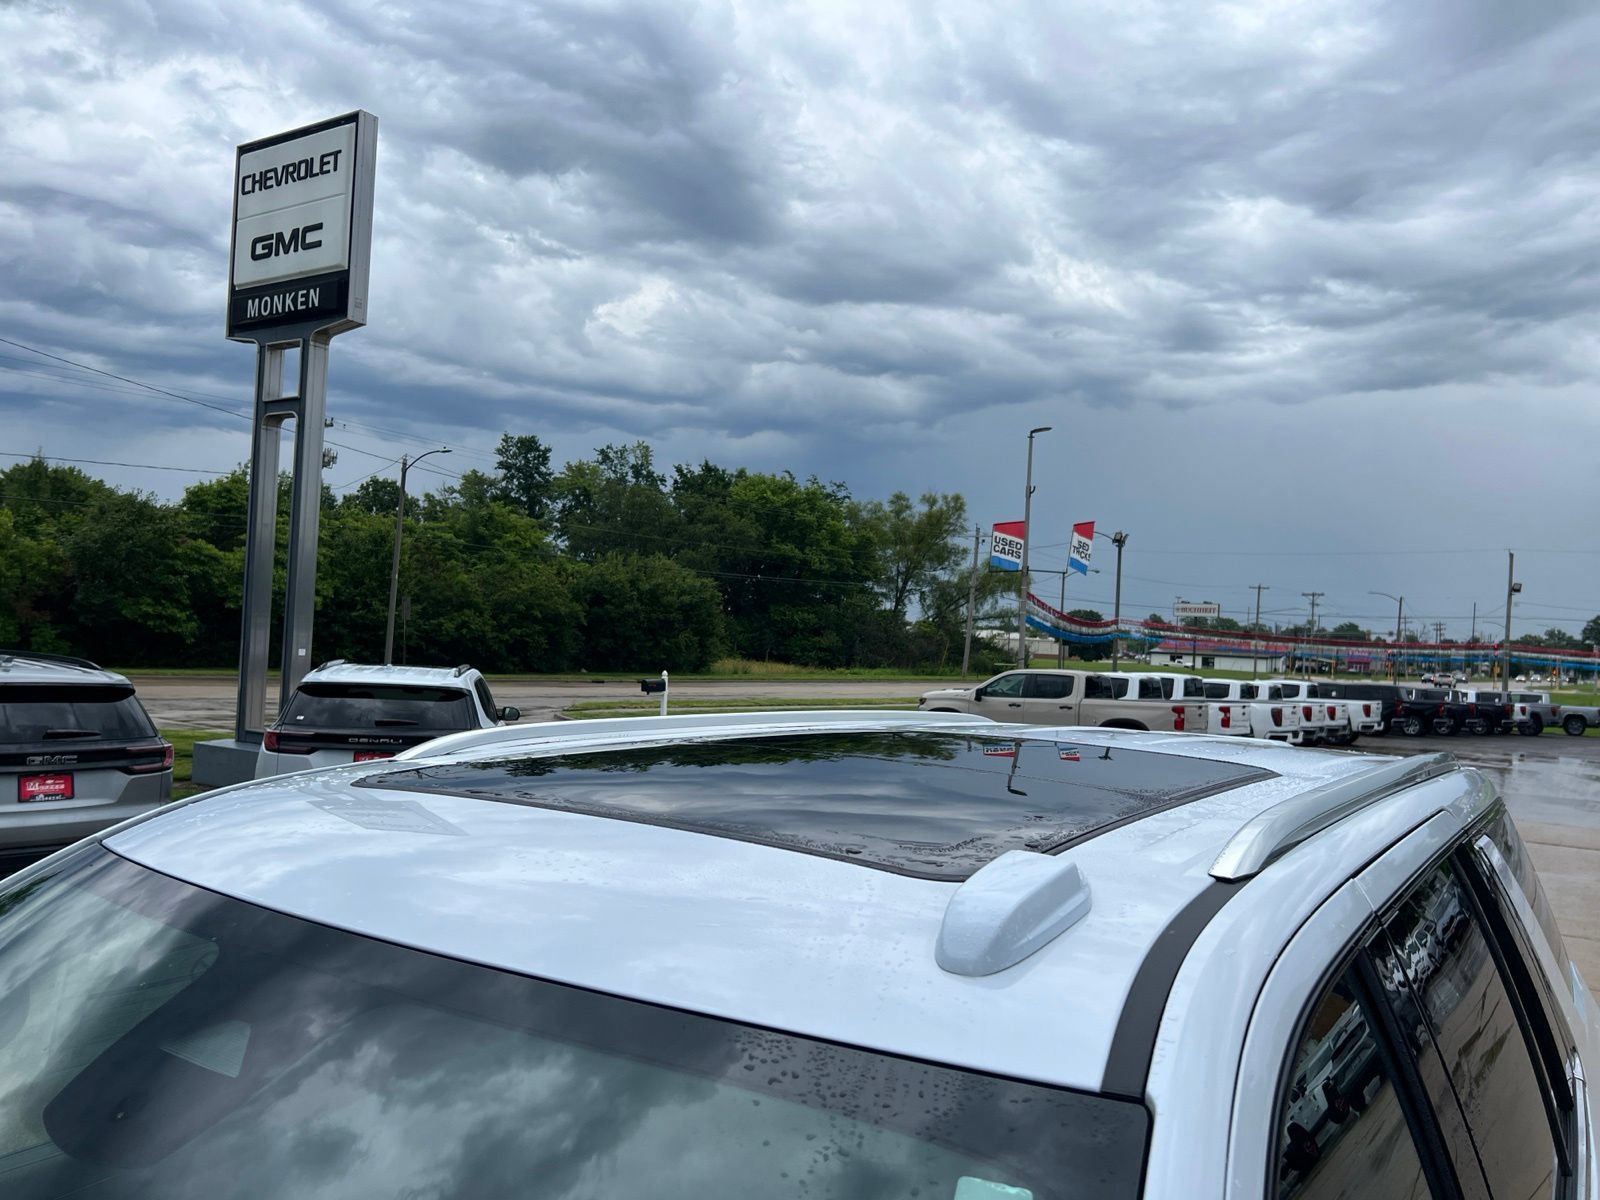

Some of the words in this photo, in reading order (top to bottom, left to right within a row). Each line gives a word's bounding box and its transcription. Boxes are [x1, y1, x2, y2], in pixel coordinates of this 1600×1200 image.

[241, 149, 342, 195] CHEVROLET
[251, 222, 323, 261] GMC
[247, 288, 320, 318] MONKEN
[993, 544, 1021, 560] CARS
[994, 536, 1023, 551] USED
[26, 754, 78, 767] GMC
